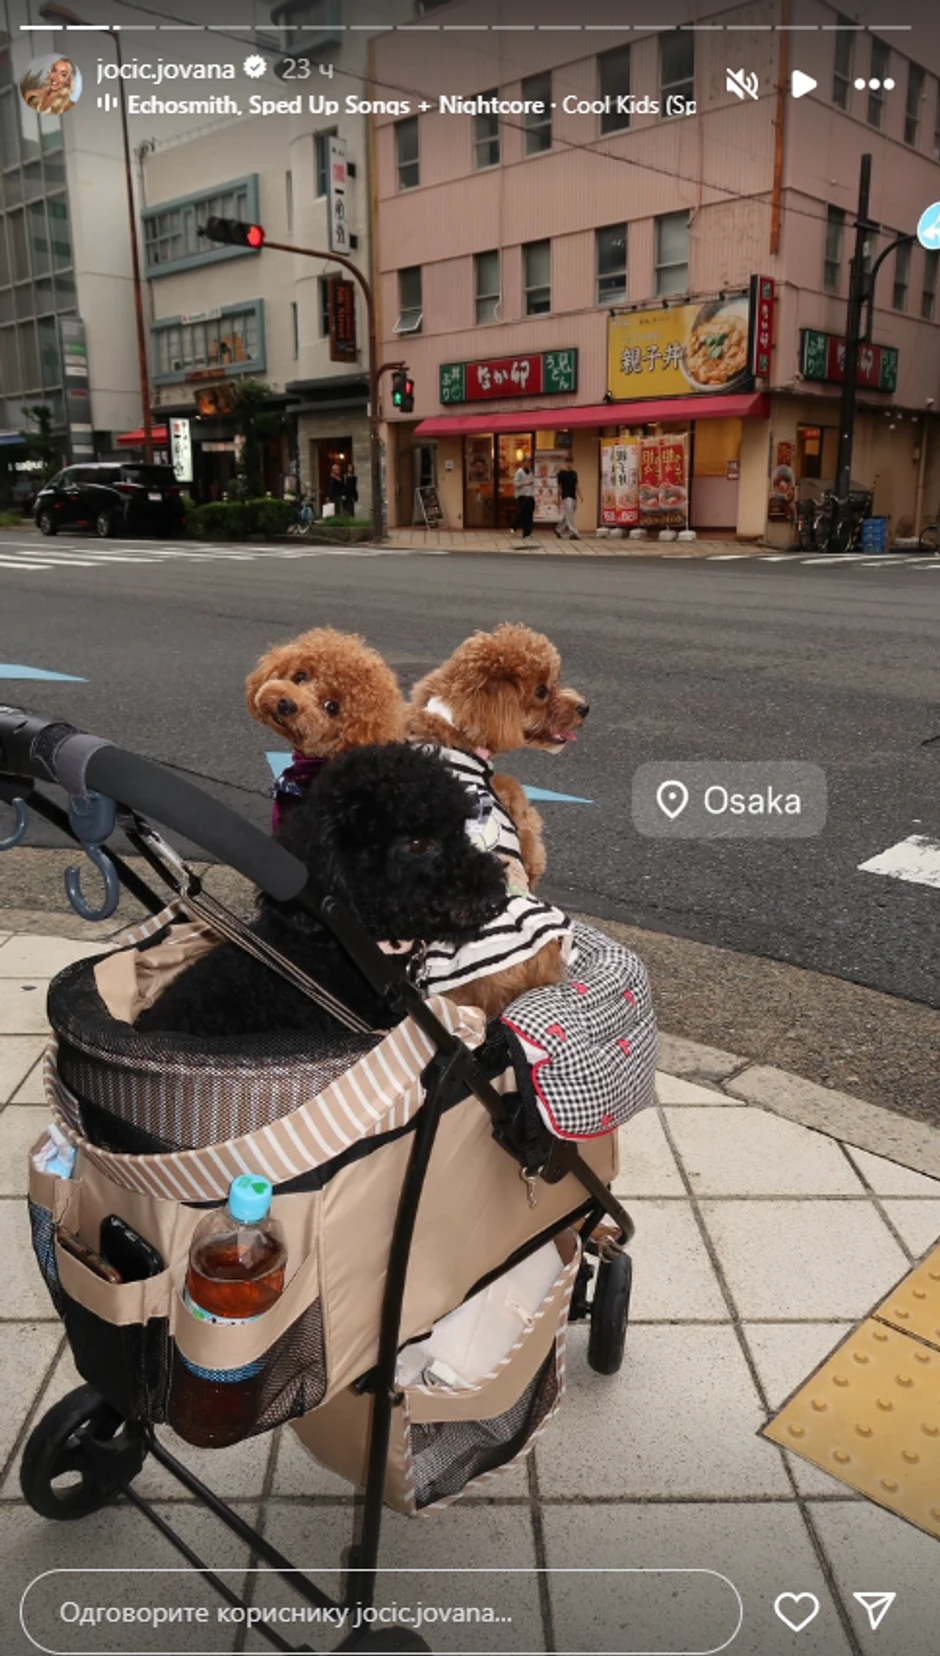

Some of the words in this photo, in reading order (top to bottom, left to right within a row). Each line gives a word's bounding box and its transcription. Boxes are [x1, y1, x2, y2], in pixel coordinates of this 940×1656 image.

[477, 359, 530, 391] なか卯
[620, 342, 684, 376] 親子丼
